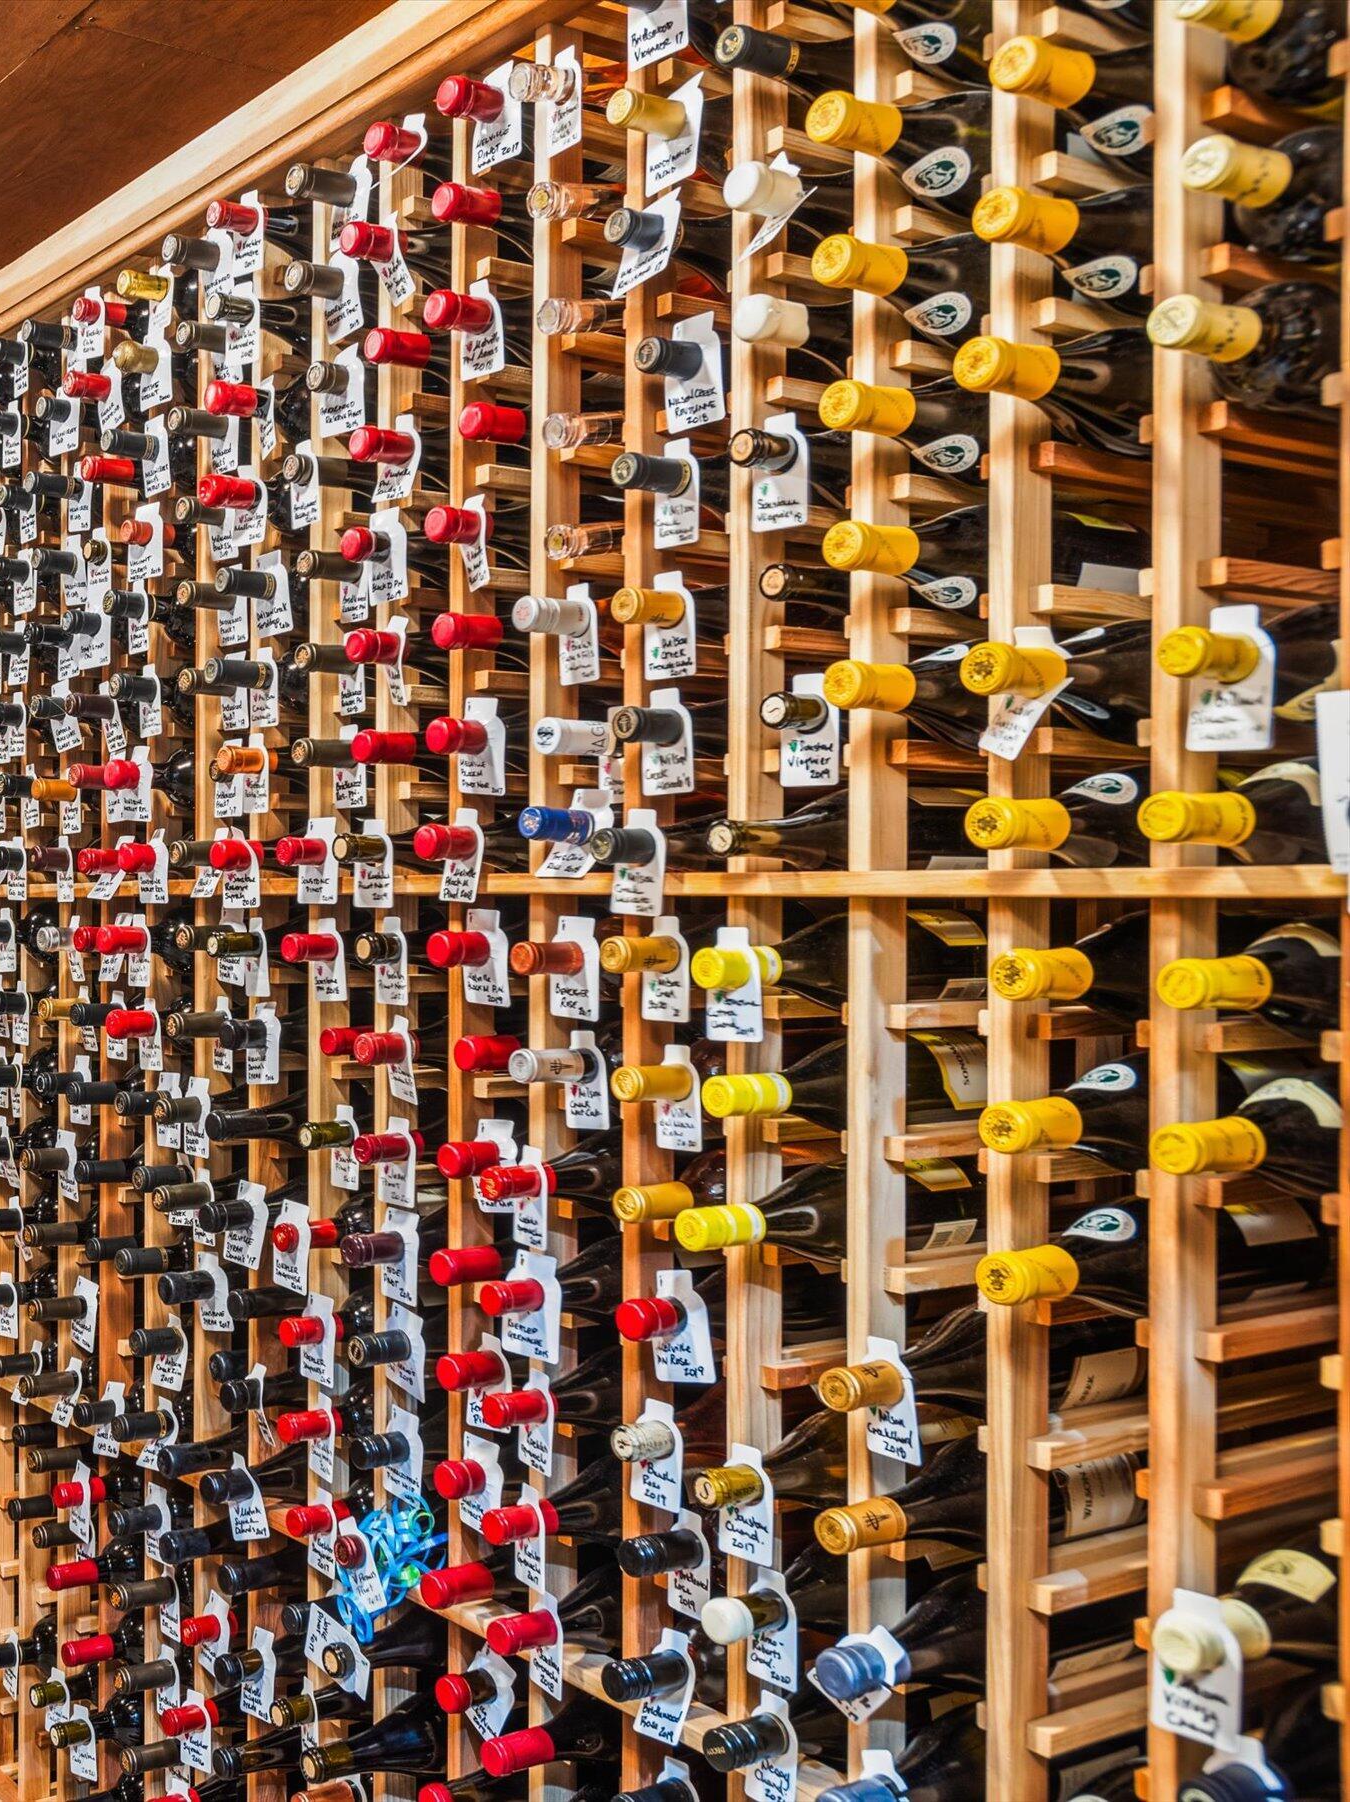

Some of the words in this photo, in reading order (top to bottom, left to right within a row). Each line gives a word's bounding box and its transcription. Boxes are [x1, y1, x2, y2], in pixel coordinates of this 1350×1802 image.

[501, 142, 519, 155] 2017
[686, 414, 708, 424] 2018
[810, 769, 831, 778] 2019
[242, 899, 257, 907] 2018
[684, 1366, 704, 1378] 2019
[884, 1441, 907, 1459] 2018
[644, 1487, 666, 1505] 2019
[732, 1538, 754, 1554] 2017
[679, 1595, 697, 1612] 2019
[770, 1671, 790, 1684] 2020
[659, 1726, 674, 1742] 2019
